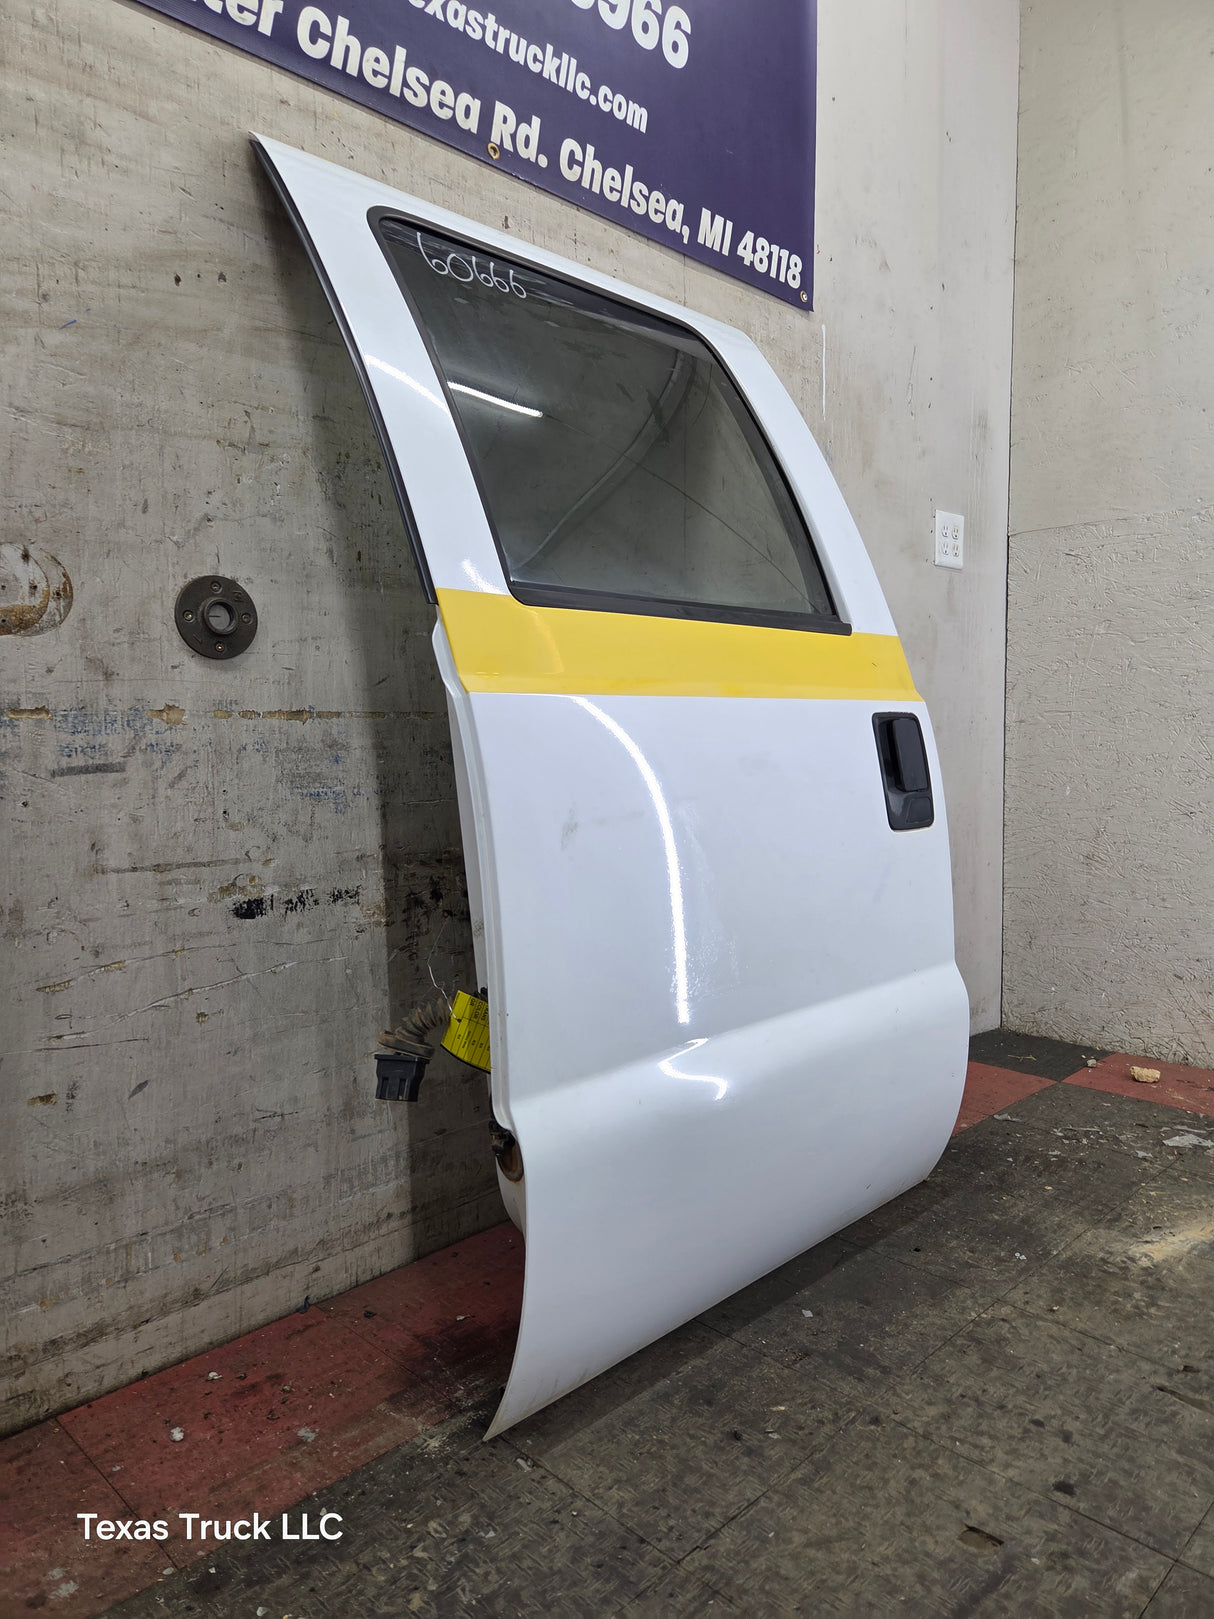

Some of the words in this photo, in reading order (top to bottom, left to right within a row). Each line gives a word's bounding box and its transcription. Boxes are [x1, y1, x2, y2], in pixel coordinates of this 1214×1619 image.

[297, 6, 482, 134] Chelsea
[490, 100, 548, 168] Rd.
[559, 137, 690, 244] Chelsea,
[697, 207, 734, 257] MI
[736, 230, 803, 289] 48118
[416, 231, 527, 299] 60666
